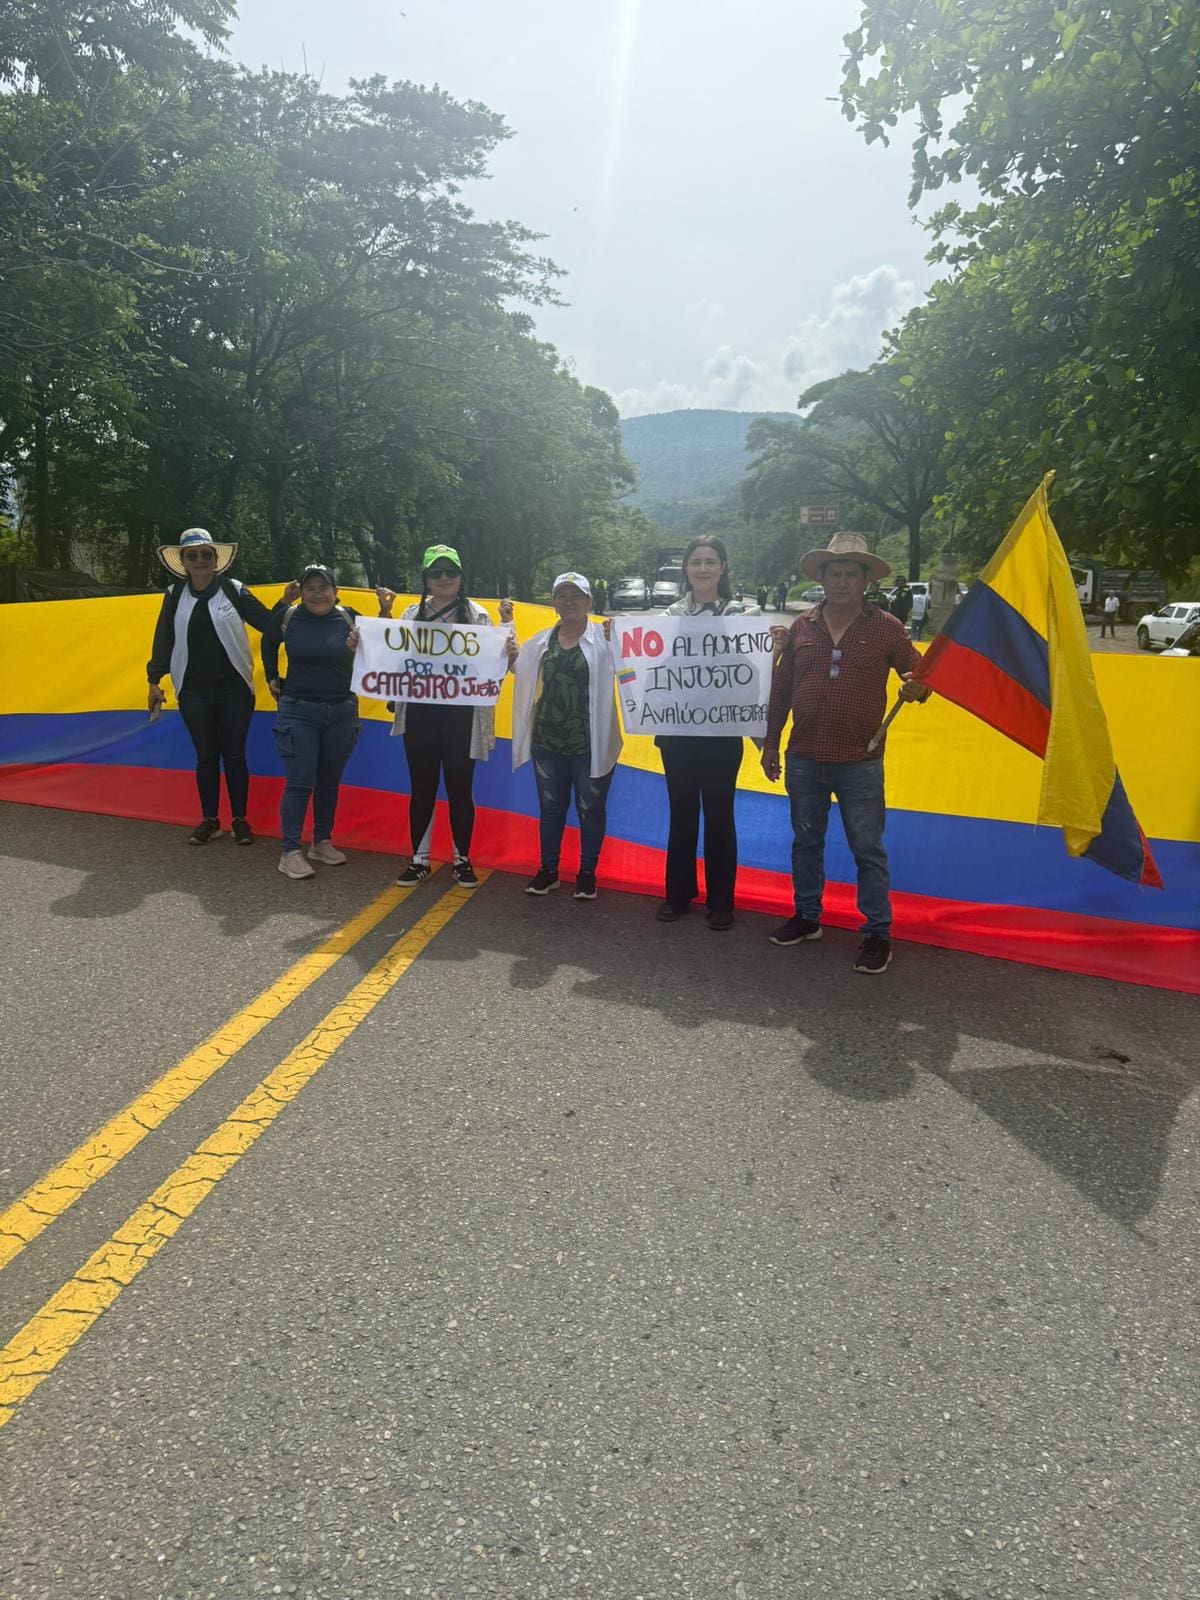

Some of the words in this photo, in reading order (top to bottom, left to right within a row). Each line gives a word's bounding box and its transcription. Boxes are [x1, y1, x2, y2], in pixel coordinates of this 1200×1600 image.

[385, 626, 480, 657] UNIDOS
[621, 626, 664, 658] NO
[672, 635, 698, 657] AL
[702, 631, 775, 657] AUMENTO
[404, 658, 433, 675] POR
[444, 663, 467, 676] UN
[645, 663, 753, 692] INJUSTO
[361, 671, 460, 699] CATASTRO
[708, 703, 769, 724] CATASTRA
